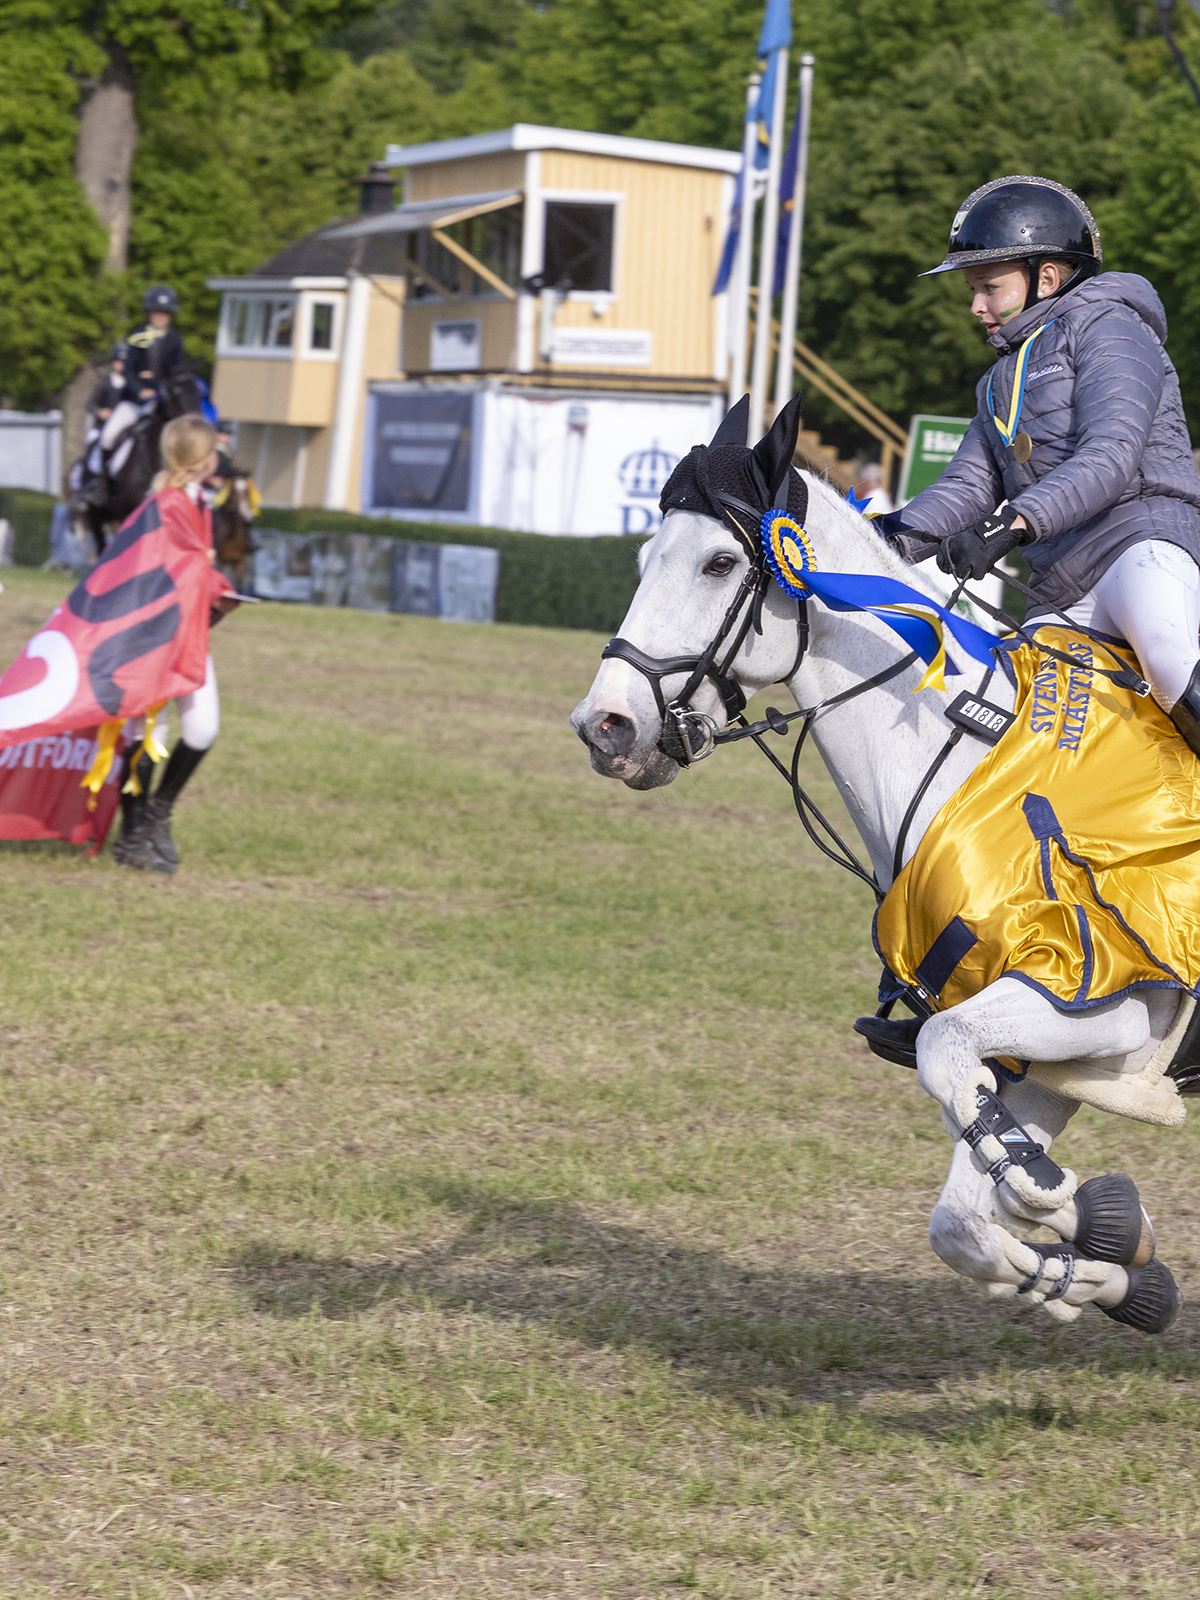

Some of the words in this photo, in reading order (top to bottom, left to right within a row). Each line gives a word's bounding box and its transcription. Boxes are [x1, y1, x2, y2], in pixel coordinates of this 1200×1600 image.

[963, 702, 1005, 731] 488
[1030, 655, 1058, 734] SVENS
[1058, 642, 1094, 752] MÄSTARE
